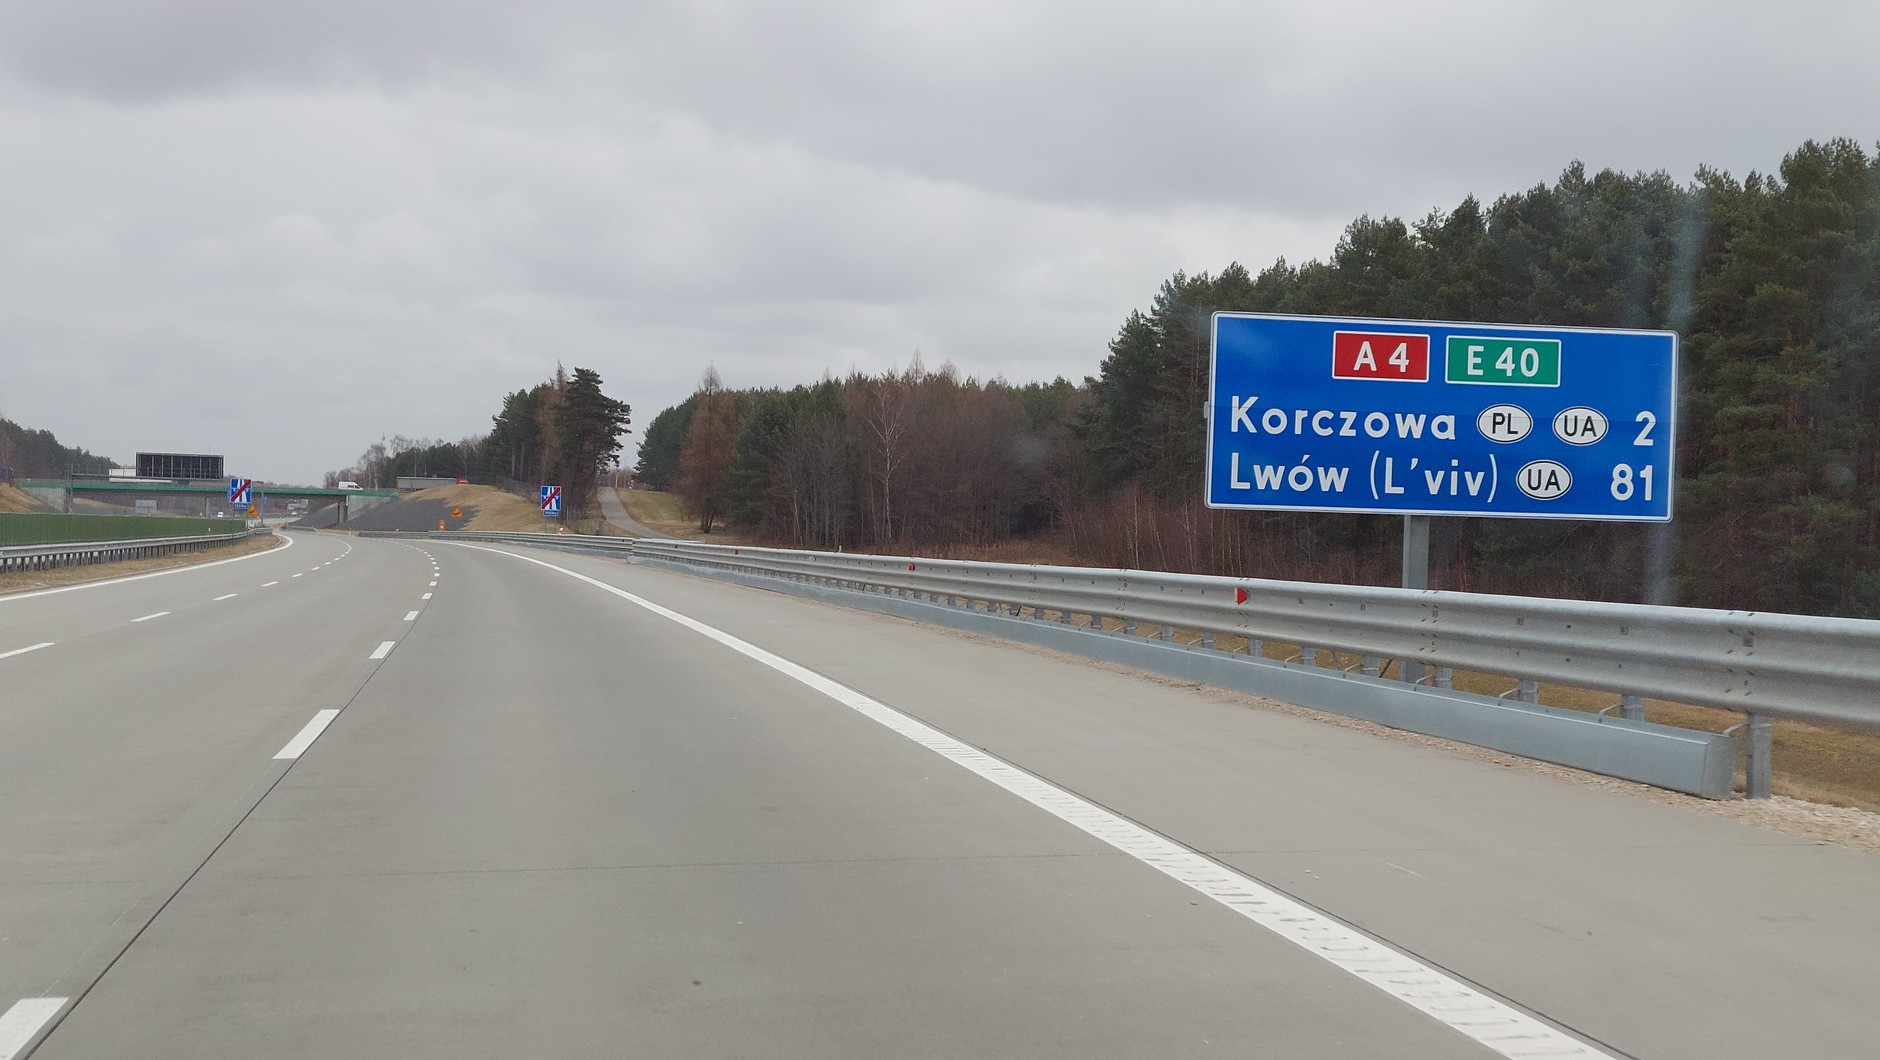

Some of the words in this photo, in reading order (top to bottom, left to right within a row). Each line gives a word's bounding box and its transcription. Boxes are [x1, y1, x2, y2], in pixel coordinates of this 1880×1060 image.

[1353, 340, 1377, 372] A
[1388, 342, 1410, 373] 4
[1467, 345, 1484, 376] E
[1495, 346, 1539, 377] 40
[1231, 395, 1456, 440] Korczowa
[1491, 412, 1519, 435] PL
[1563, 414, 1597, 437] UA
[1633, 410, 1656, 446] 2
[1230, 452, 1349, 492] Lwów
[1527, 468, 1561, 491] UA
[1610, 463, 1653, 501] 81
